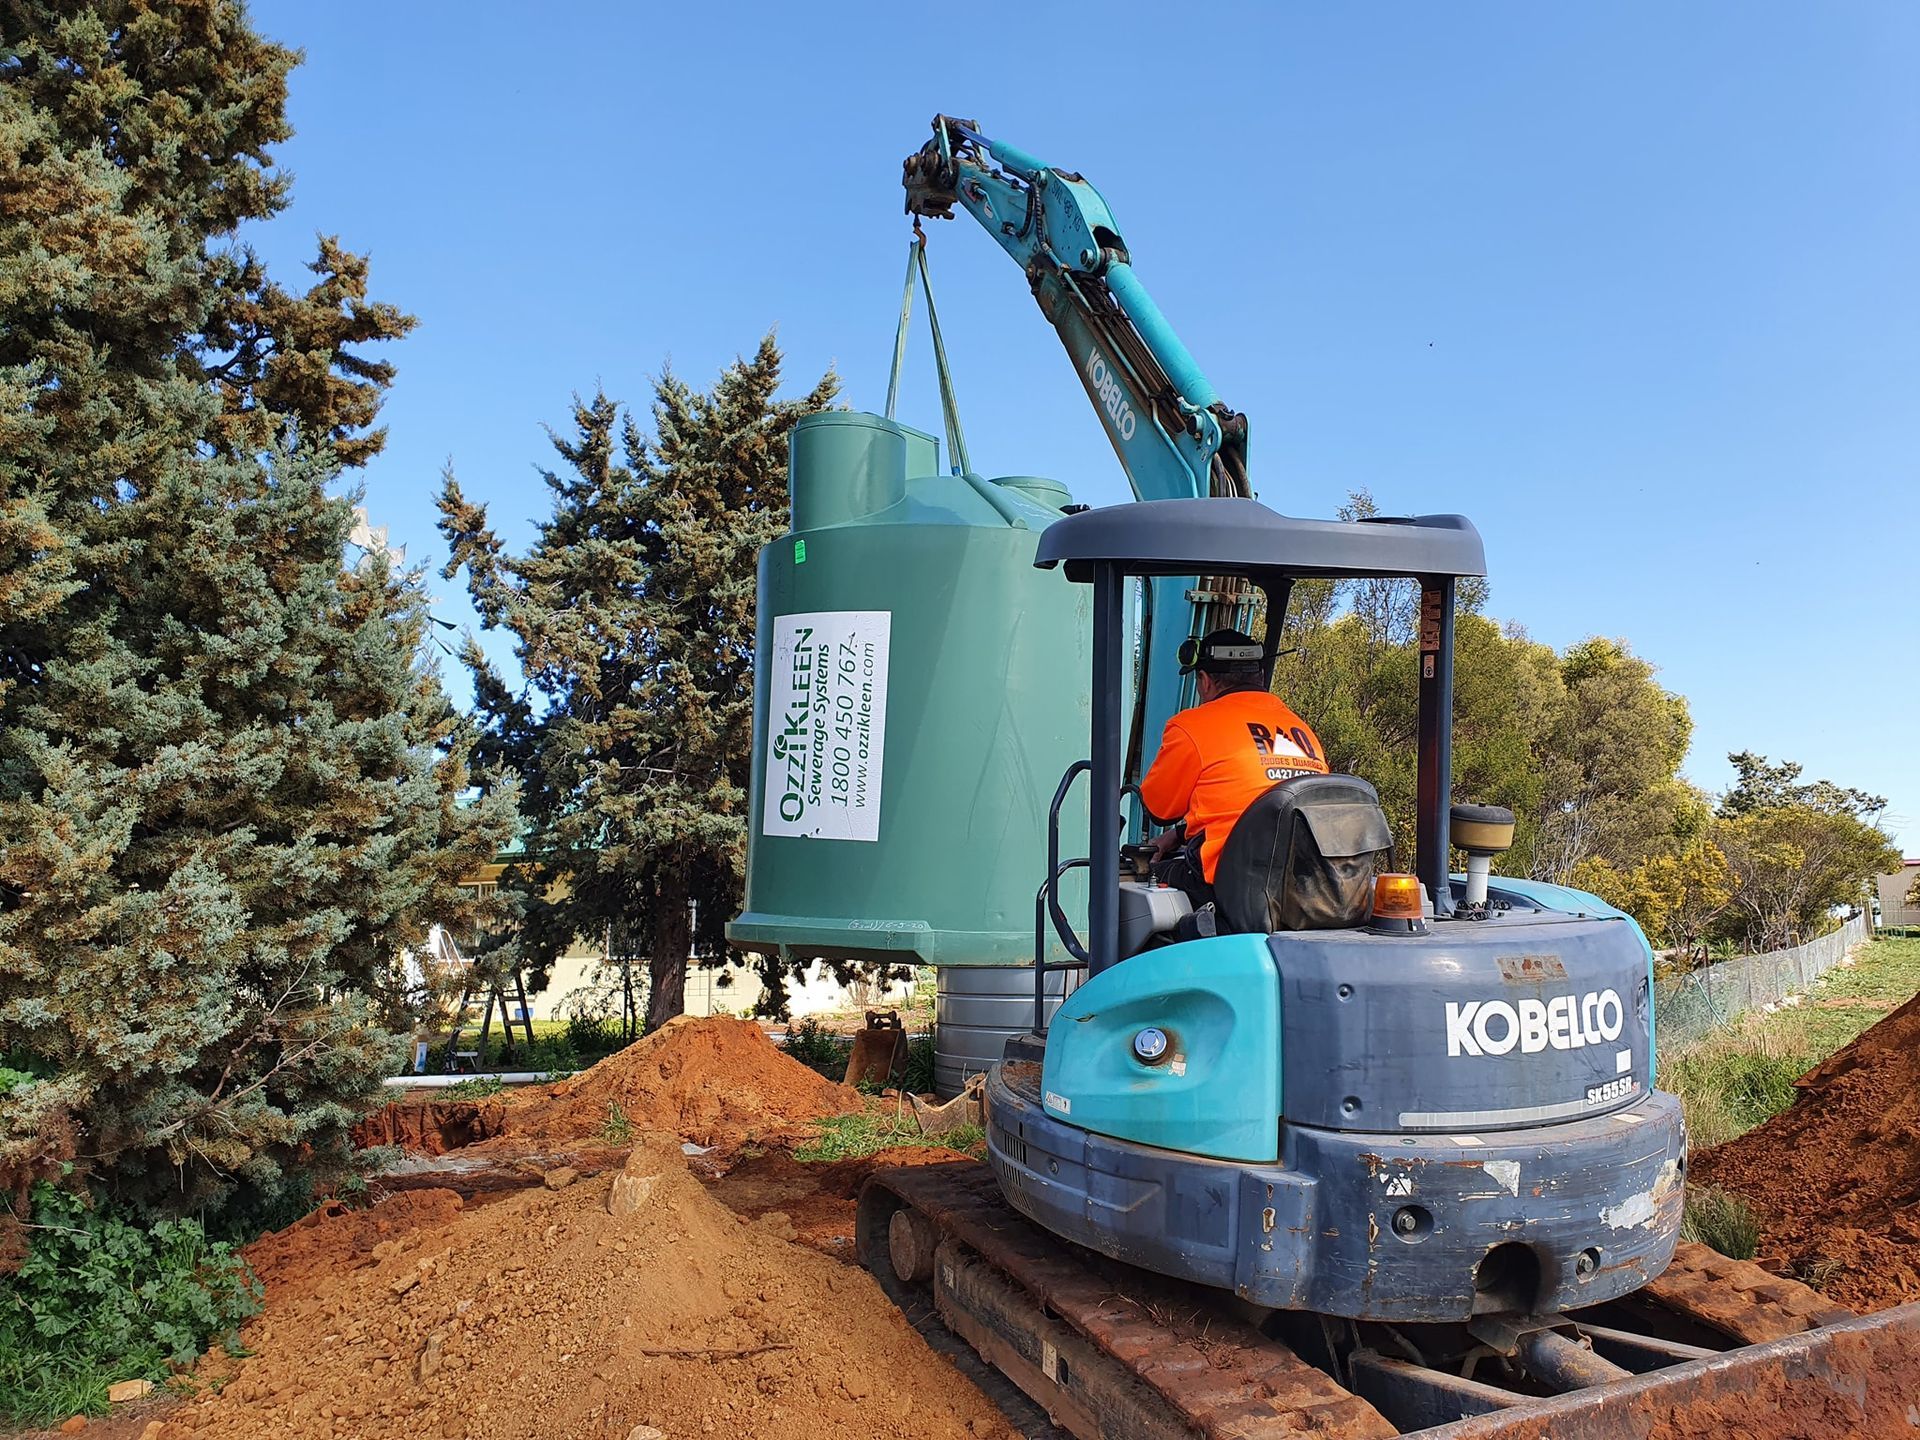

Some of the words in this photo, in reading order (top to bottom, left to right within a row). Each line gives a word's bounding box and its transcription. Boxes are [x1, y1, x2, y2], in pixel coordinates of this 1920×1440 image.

[1085, 346, 1136, 441] KOBELCO
[813, 643, 831, 714] Systems
[838, 642, 857, 687] 767
[836, 695, 854, 741] 450
[855, 642, 875, 808] www.ozzikleen.com
[808, 718, 829, 807] Sewerage
[831, 746, 851, 808] 1800
[1260, 756, 1290, 766] RIDGES
[1267, 768, 1292, 780] 0427
[1445, 988, 1624, 1057] KOBELCO
[1587, 1075, 1633, 1106] SK55SR
